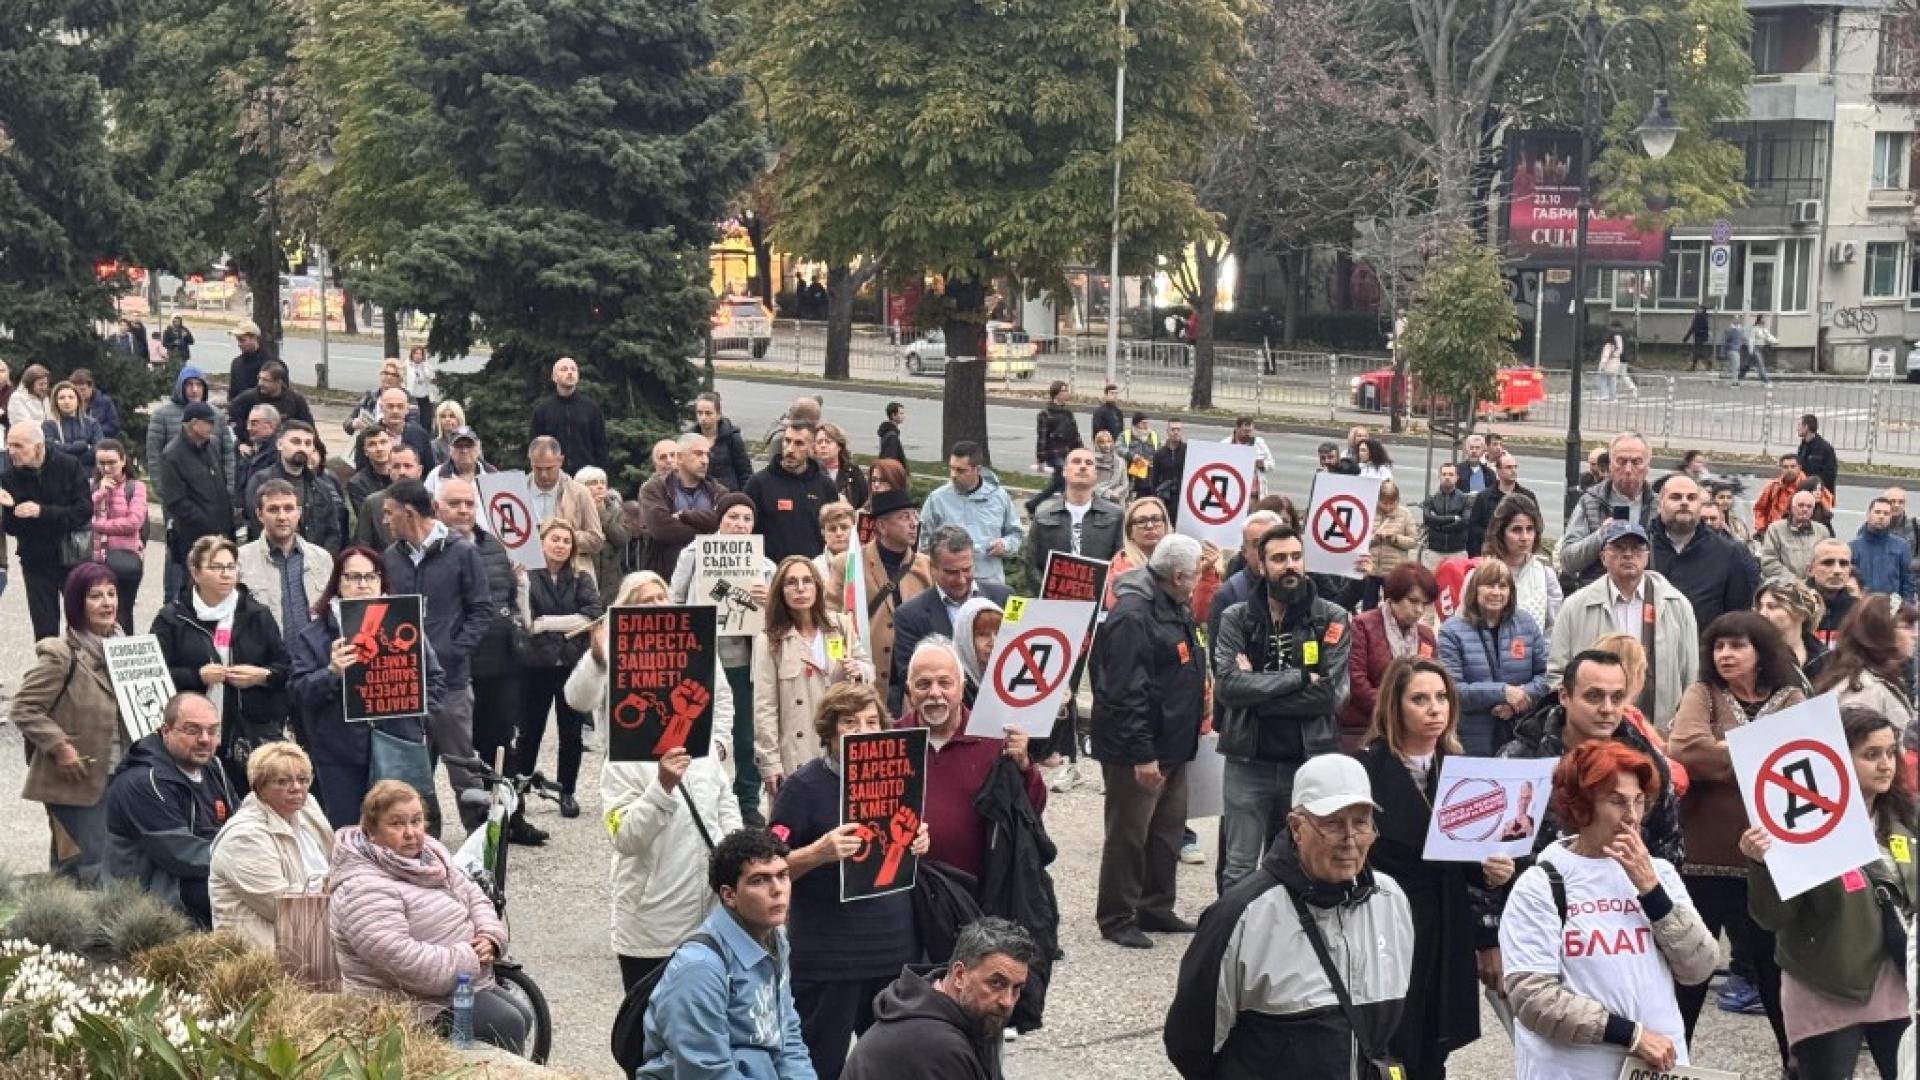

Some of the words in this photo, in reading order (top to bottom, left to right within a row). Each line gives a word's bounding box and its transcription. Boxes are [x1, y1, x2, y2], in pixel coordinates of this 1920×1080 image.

[1533, 194, 1561, 206] 23.10
[1533, 207, 1606, 221] ГАБРИЛА
[703, 541, 753, 554] ОТКОГА
[703, 556, 741, 568] СЪДЪТ
[745, 556, 752, 567] Е
[618, 613, 676, 632] БЛАГО
[681, 613, 691, 631] Е
[618, 634, 628, 652] В
[633, 632, 703, 652] АРЕСТА,
[618, 651, 688, 671] ЗАЩОТО
[617, 672, 627, 688] Е
[848, 740, 896, 760] БЛАГО
[899, 738, 907, 757] Е
[848, 764, 858, 782] В
[861, 758, 916, 780] АРЕСТА,
[848, 778, 904, 801] ЗАЩОТО
[848, 804, 858, 820] Е
[1565, 926, 1651, 957] БЛАГ
